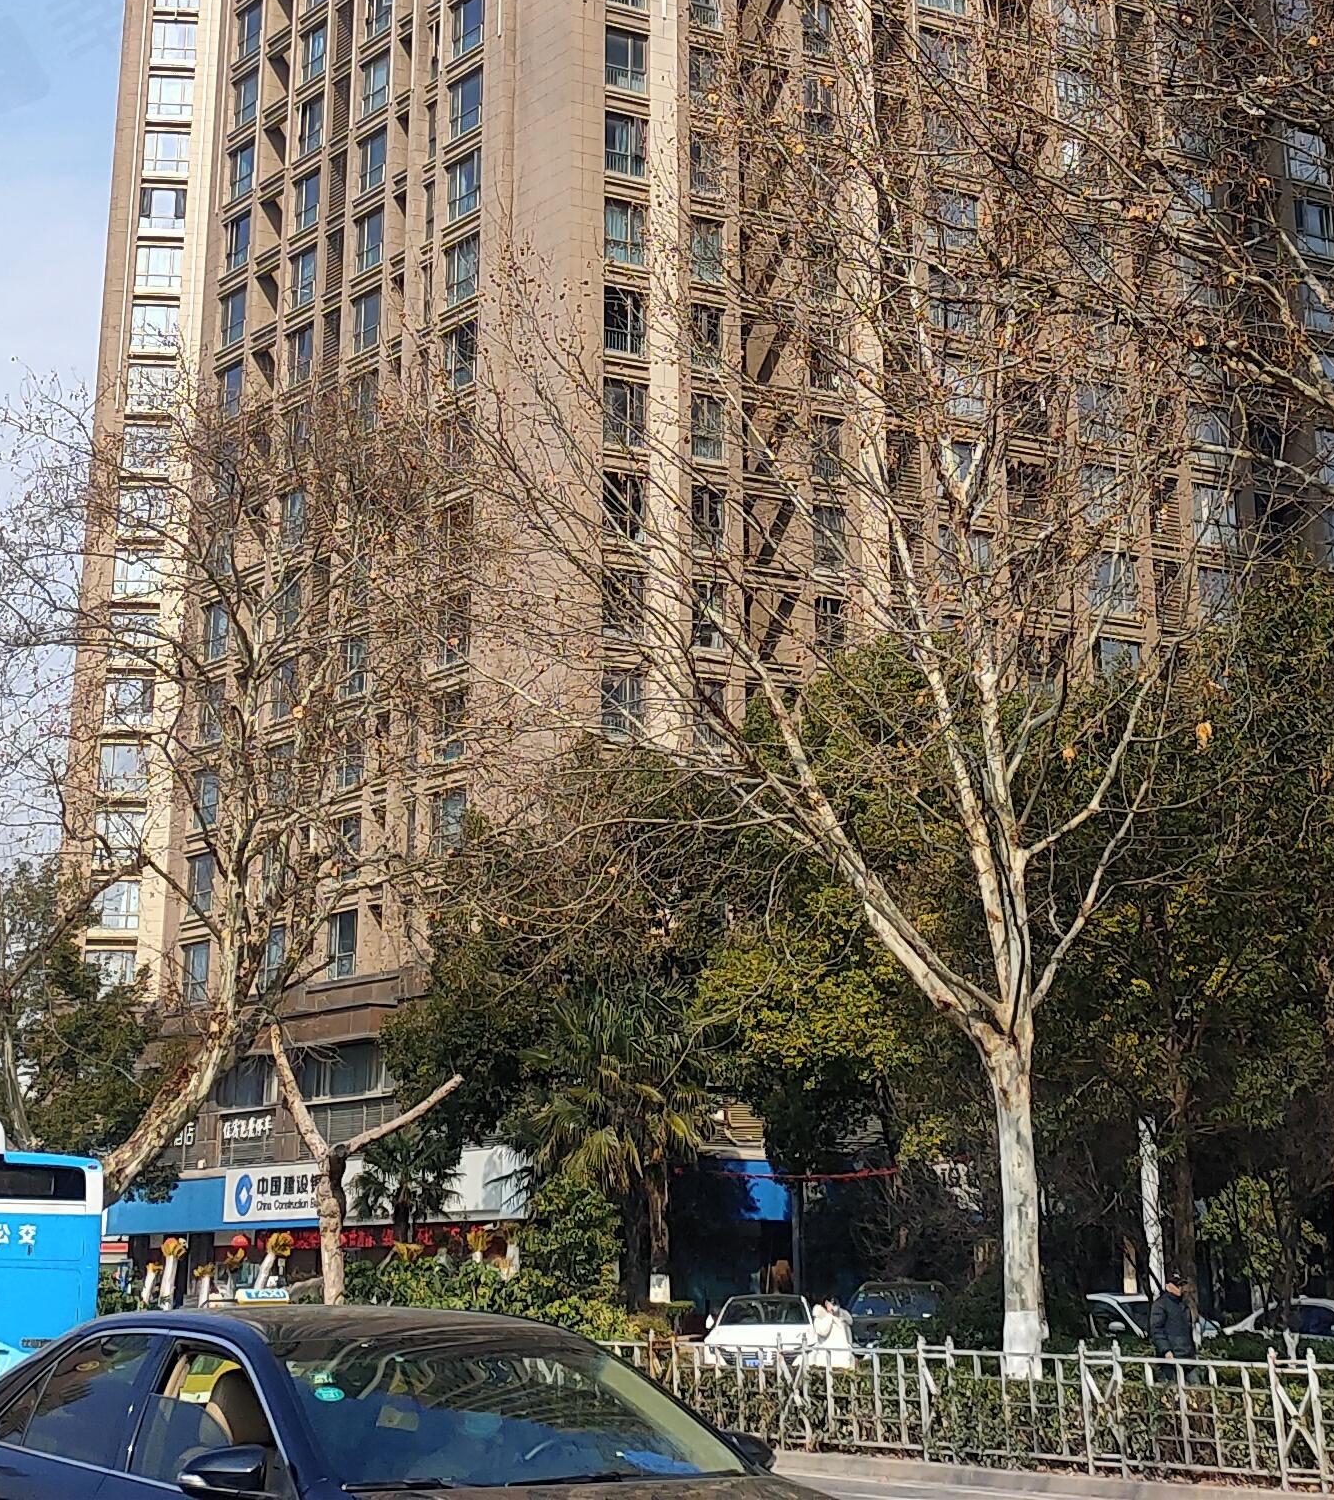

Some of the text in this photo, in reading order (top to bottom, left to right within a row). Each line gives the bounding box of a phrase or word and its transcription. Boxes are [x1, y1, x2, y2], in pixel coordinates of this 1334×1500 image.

[257, 1174, 321, 1197] 中国建设银
[256, 1200, 271, 1211] China
[274, 1198, 308, 1210] Construction
[250, 1289, 285, 1298] TAXI
